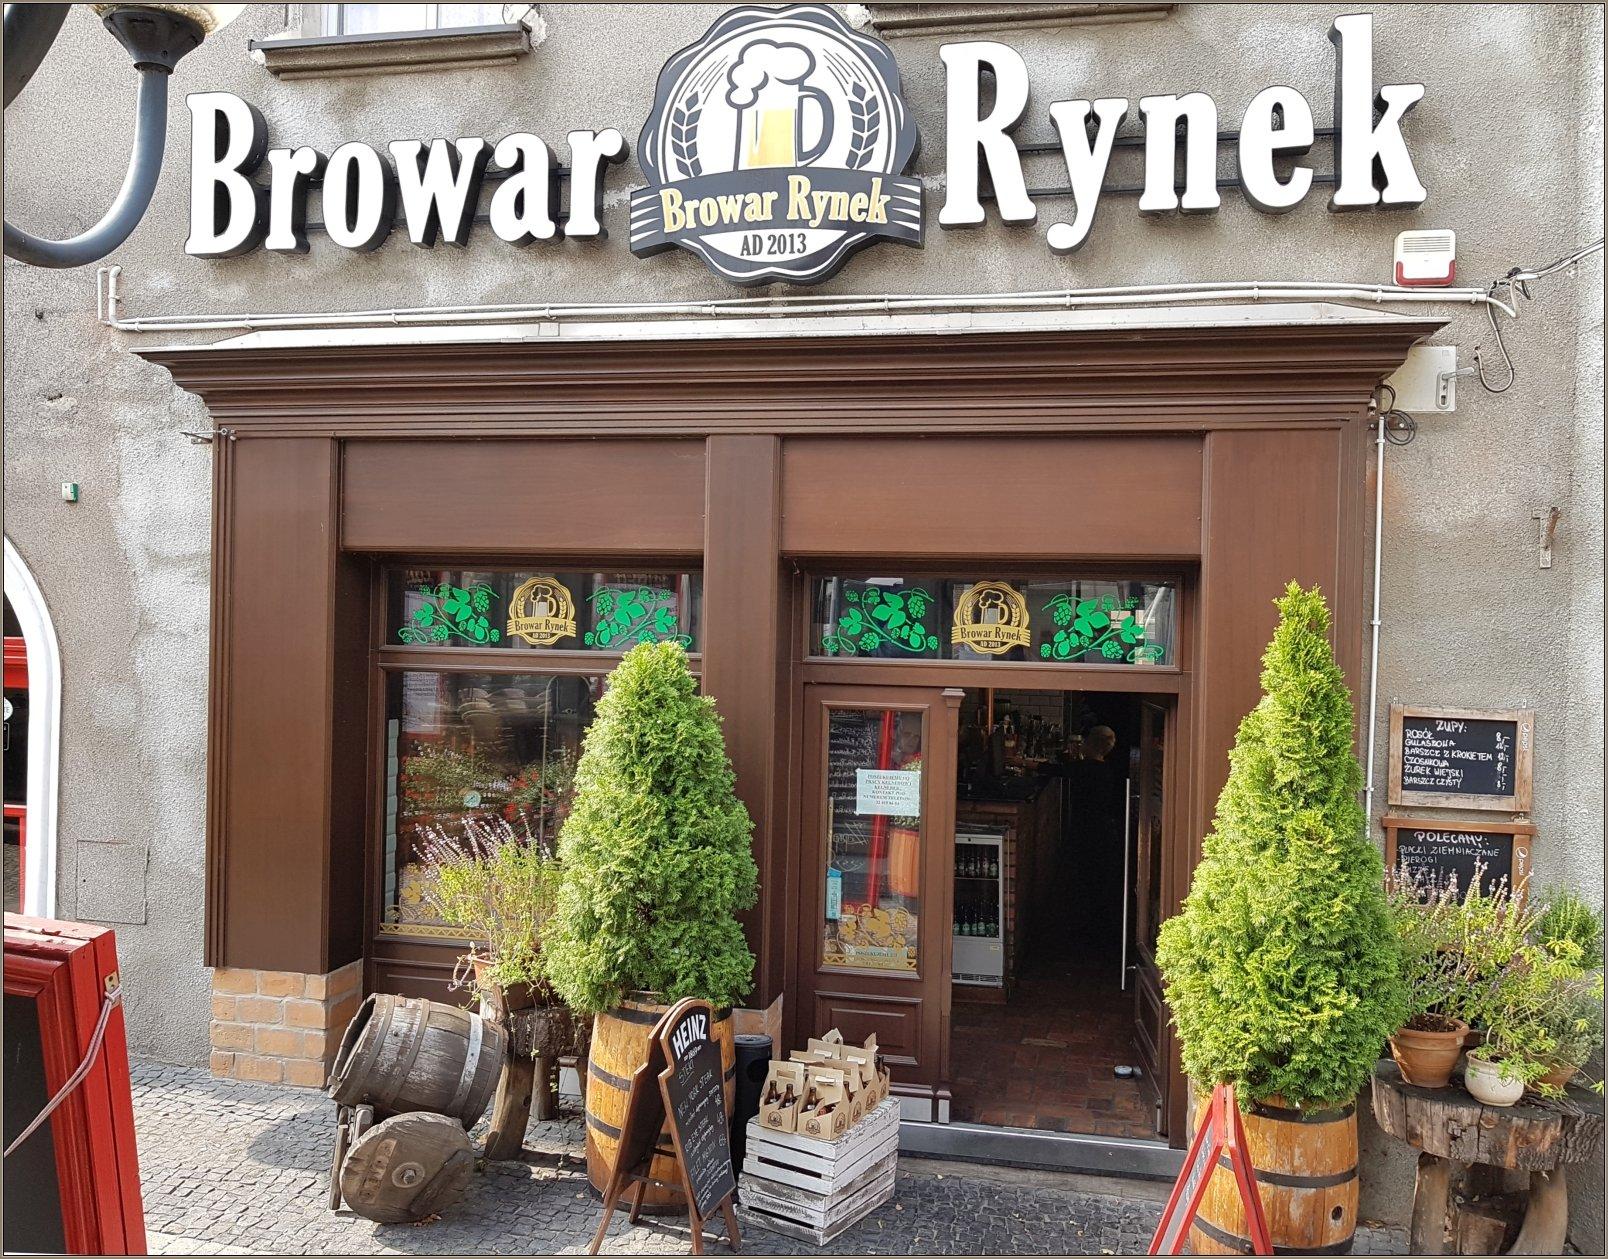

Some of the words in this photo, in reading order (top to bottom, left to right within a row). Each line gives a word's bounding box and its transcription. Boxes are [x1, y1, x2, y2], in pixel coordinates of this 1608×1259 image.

[938, 12, 1427, 255] Rynek
[185, 91, 630, 259] Browar
[659, 187, 778, 233] Browar
[786, 174, 891, 228] Rynek
[740, 234, 763, 256] AD
[768, 233, 807, 256] 2013
[514, 620, 543, 632] Browar
[545, 619, 569, 633] Rynek
[960, 626, 992, 639] Browar
[994, 626, 1022, 641] Rynek
[1436, 720, 1467, 733] ZUPY:
[1443, 750, 1450, 758] Z
[1451, 749, 1493, 761] KROKIETEM
[1414, 831, 1489, 848] POLECAMY:
[672, 1014, 707, 1060] HEINZ
